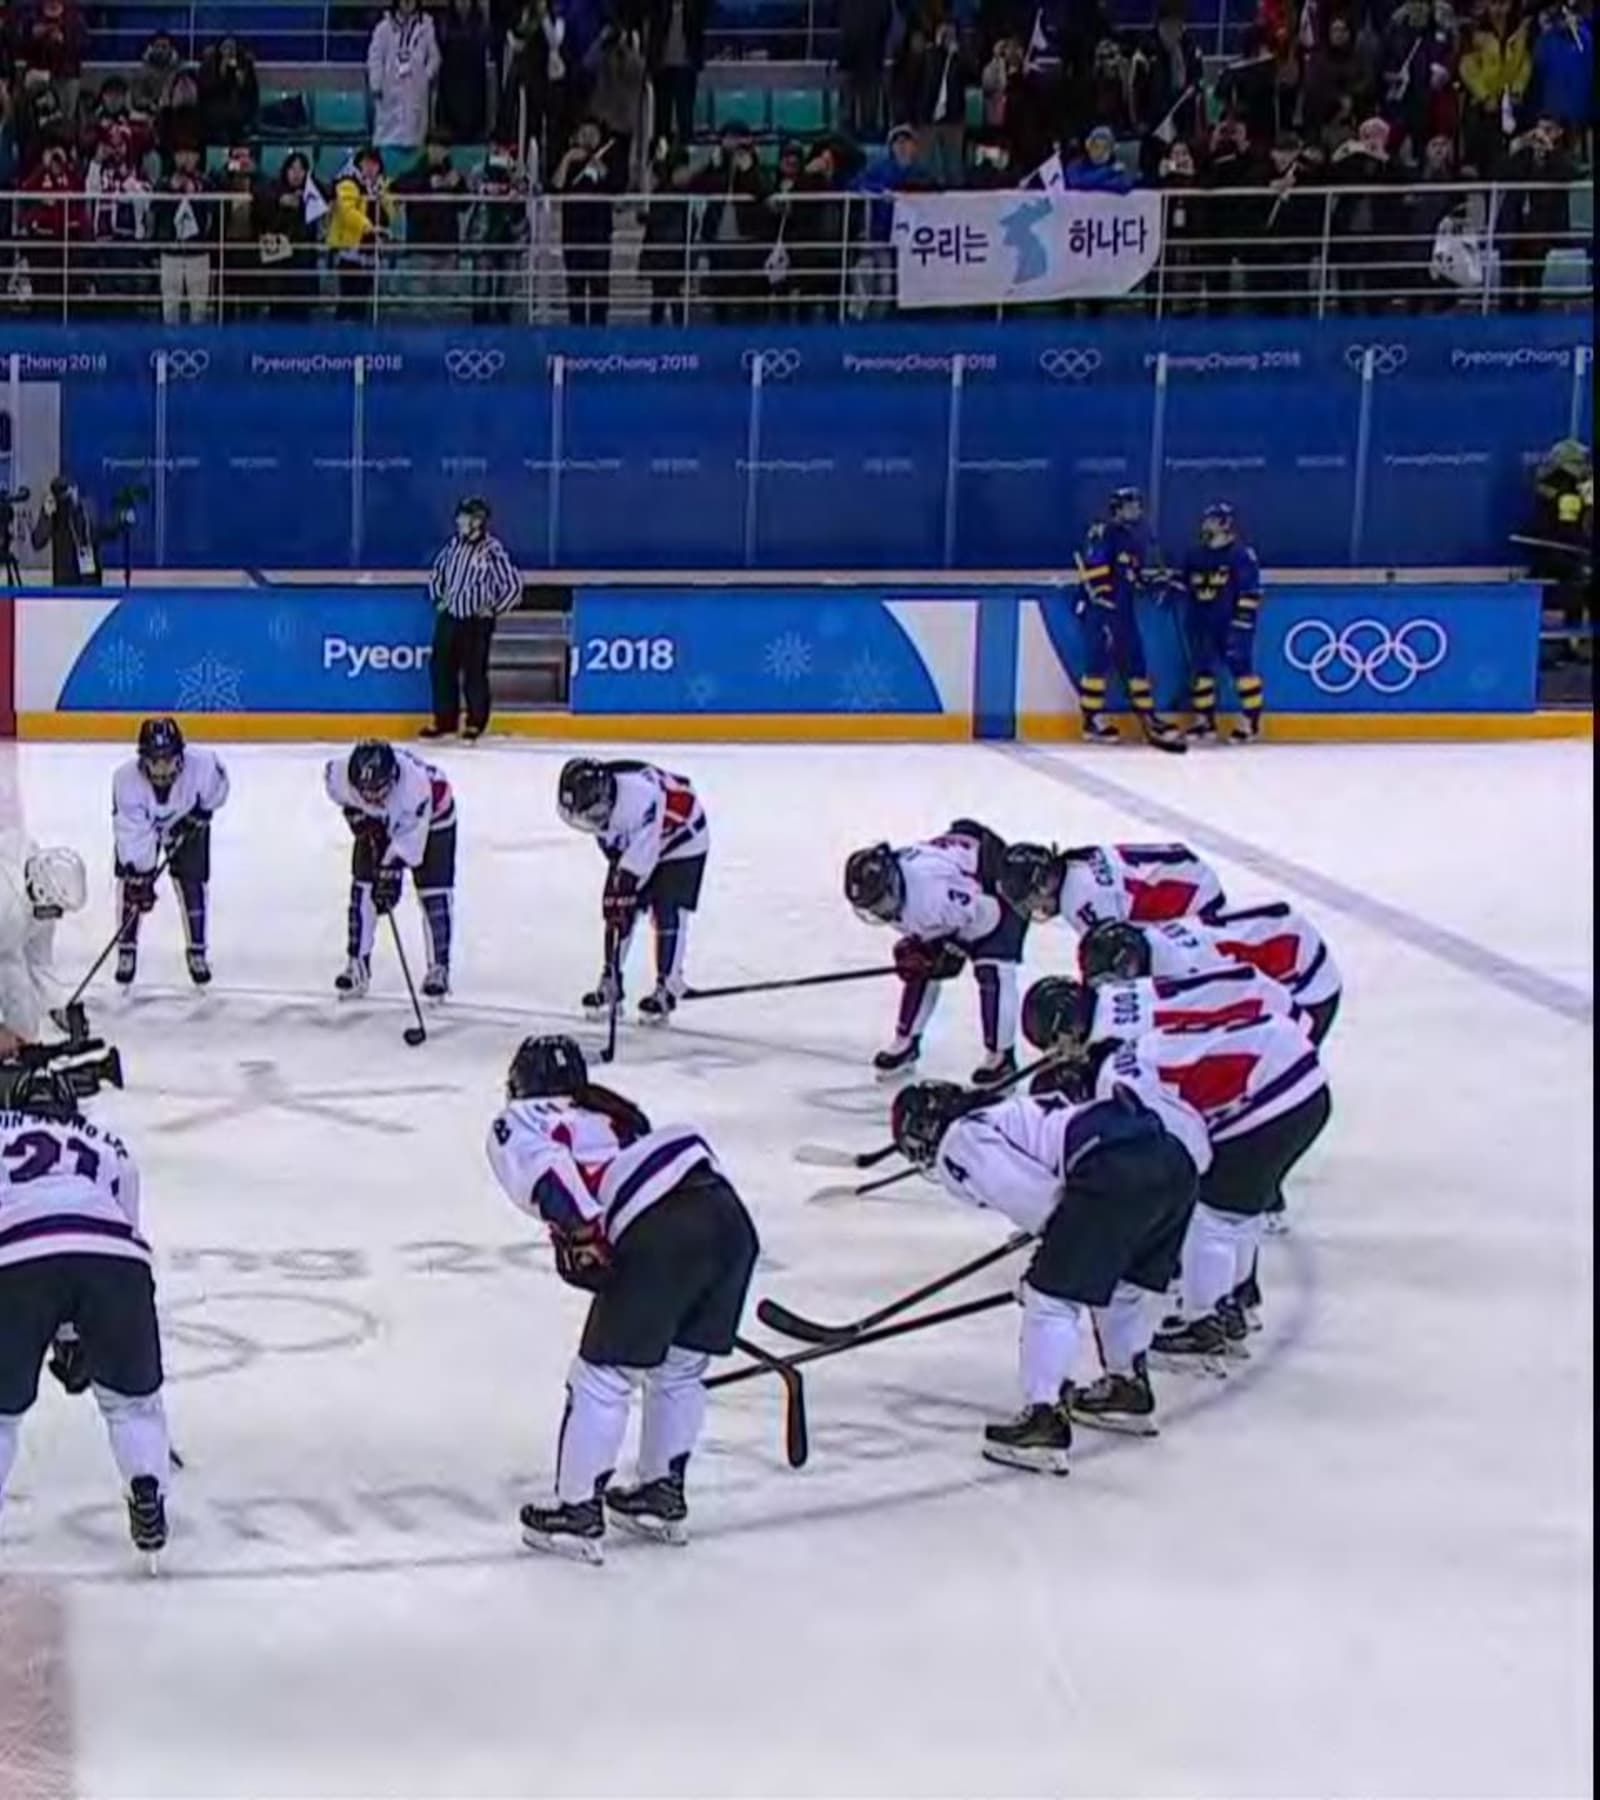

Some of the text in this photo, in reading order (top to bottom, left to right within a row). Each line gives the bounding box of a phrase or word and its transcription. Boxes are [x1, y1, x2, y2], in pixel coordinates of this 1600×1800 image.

[911, 215, 1147, 267] 우리는 하나다
[660, 355, 699, 370] 2018
[586, 638, 675, 671] 2018
[2, 1129, 100, 1185] 21
